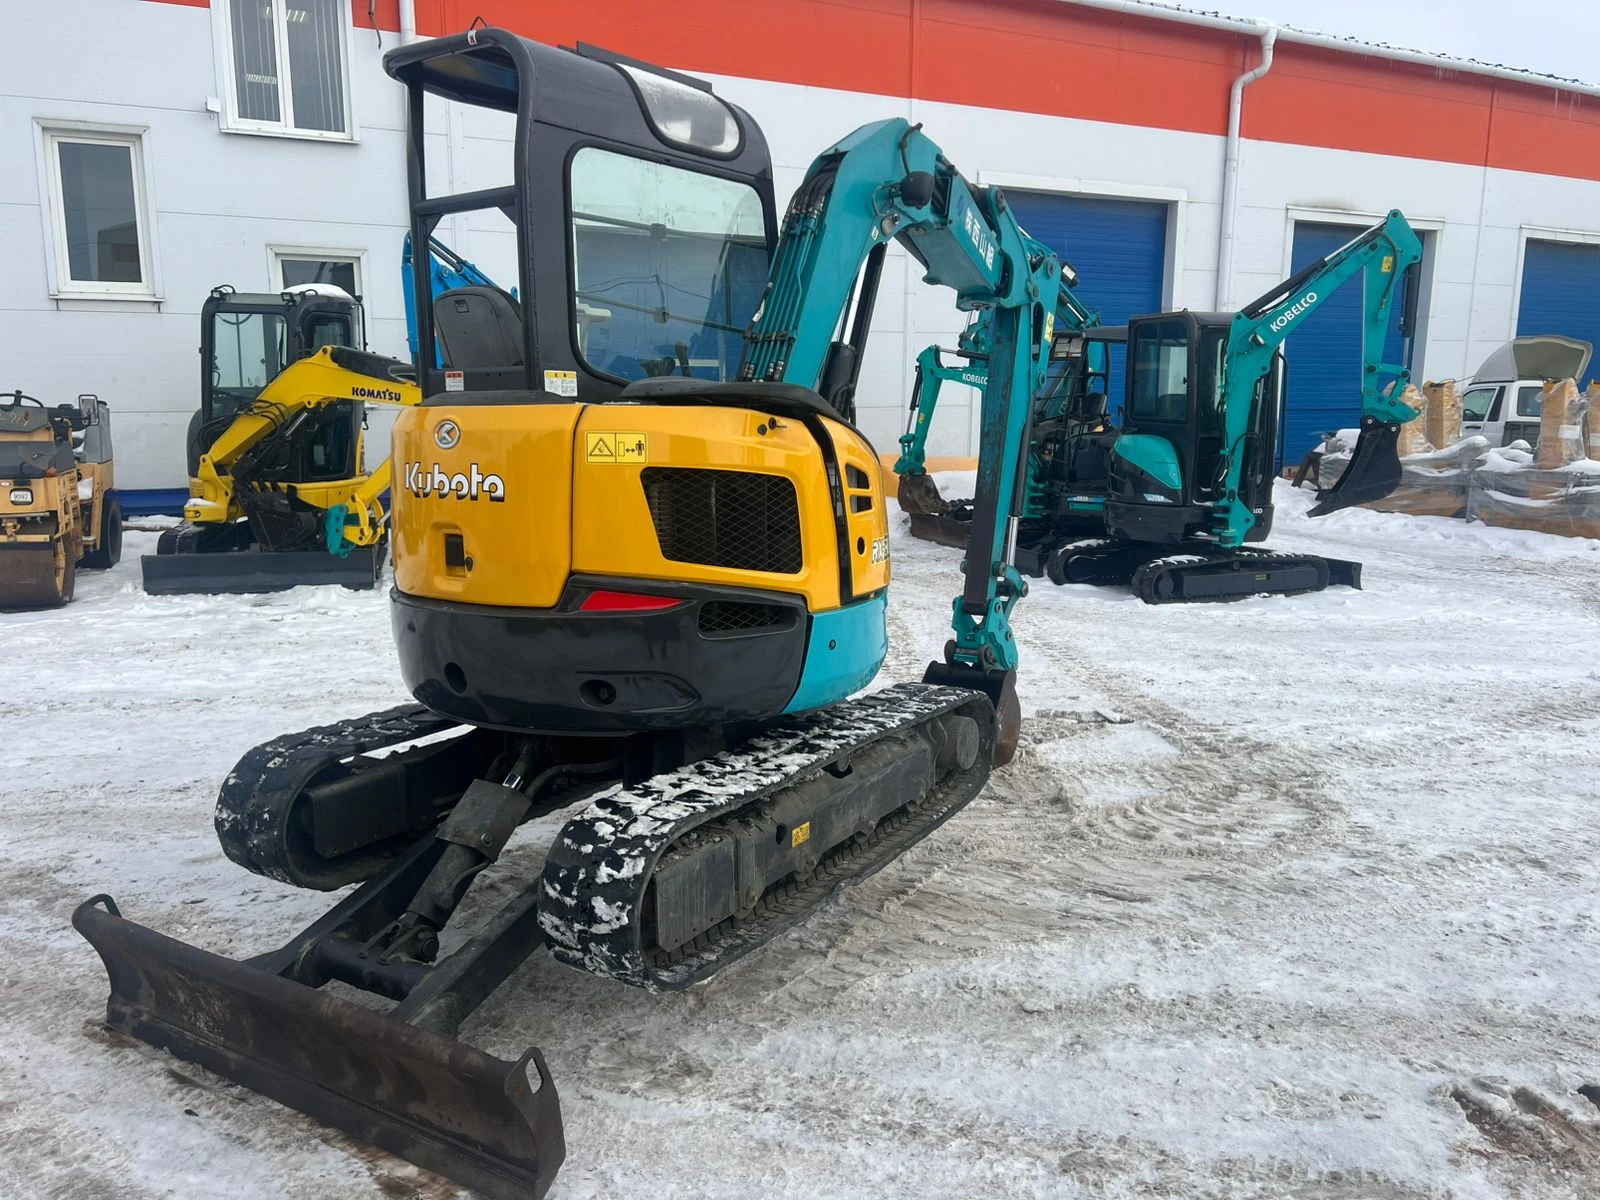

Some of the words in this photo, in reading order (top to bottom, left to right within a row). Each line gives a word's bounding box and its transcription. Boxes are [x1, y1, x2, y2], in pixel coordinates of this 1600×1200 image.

[1270, 292, 1317, 333] KOBELCO
[352, 386, 401, 401] KOMATSU
[405, 461, 505, 502] Kubota
